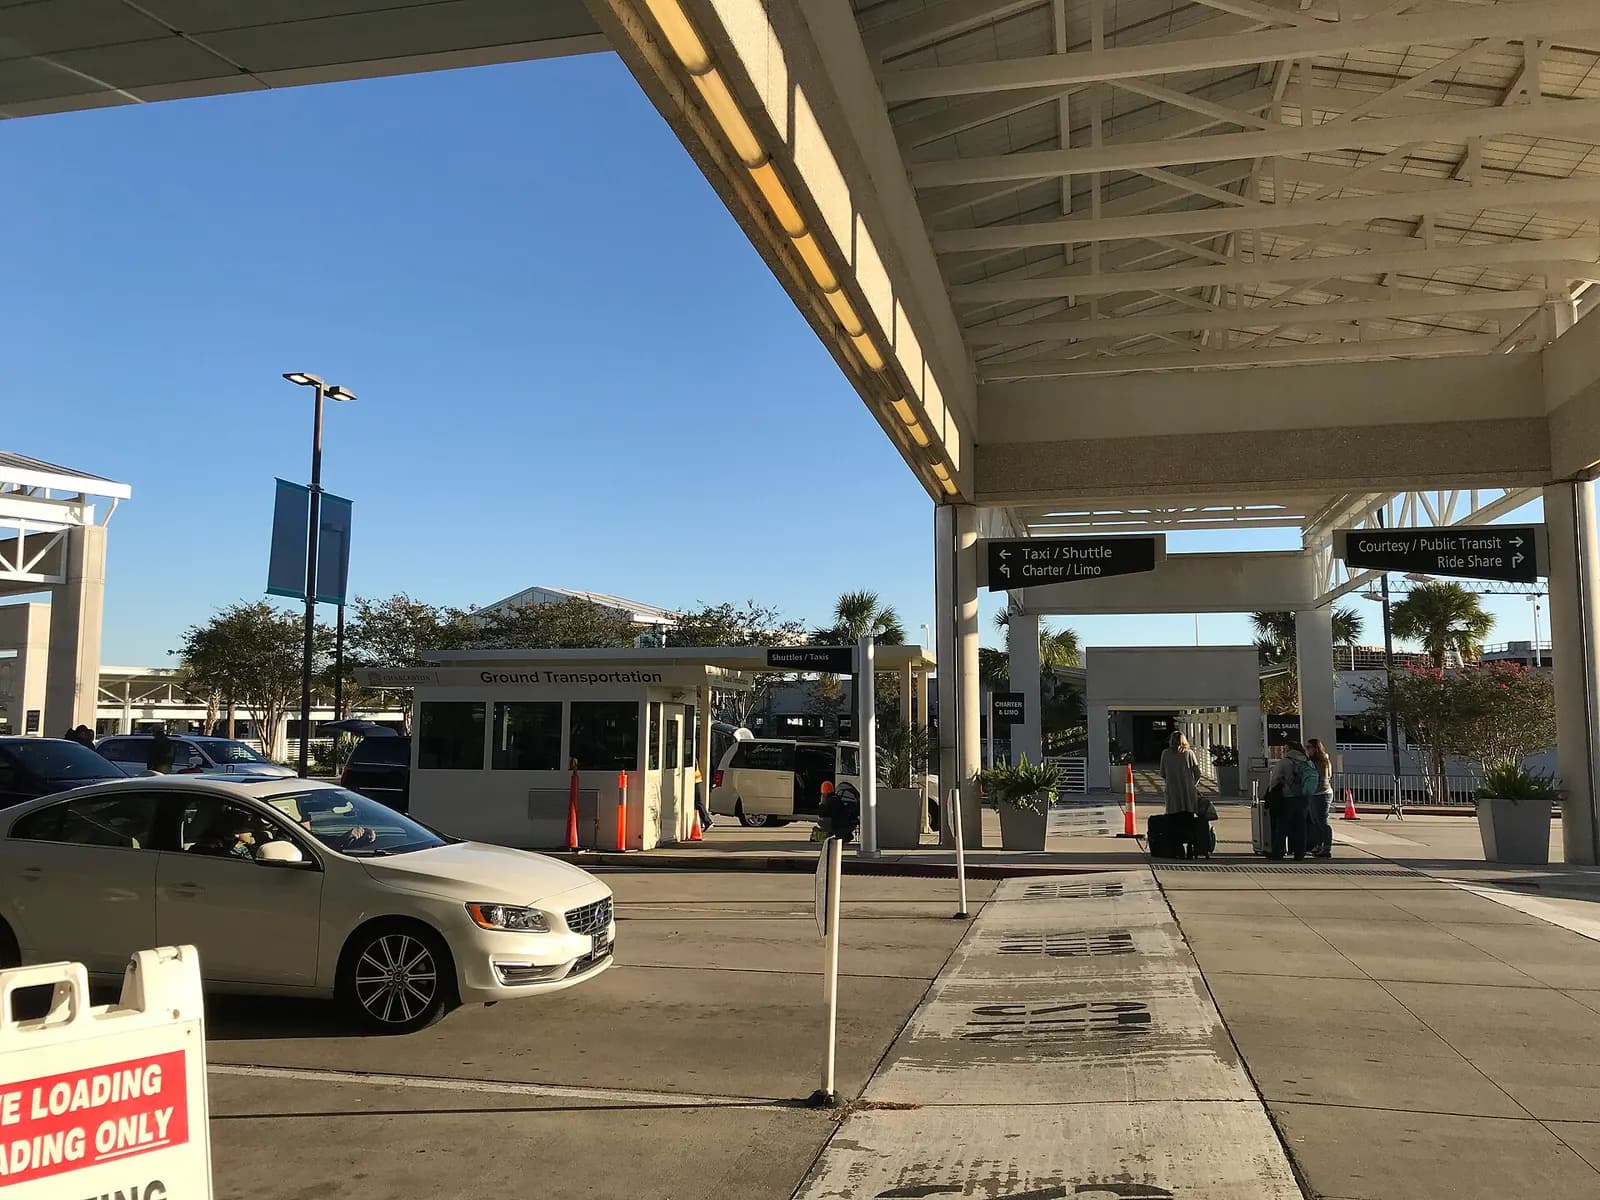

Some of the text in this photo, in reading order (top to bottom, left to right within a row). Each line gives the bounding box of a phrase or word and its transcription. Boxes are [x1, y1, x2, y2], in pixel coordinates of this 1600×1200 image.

[1359, 536, 1502, 553] Courtesy / Public Transit
[1022, 546, 1112, 560] Taxi / Shuttle
[1437, 554, 1503, 569] Ride Share
[1022, 563, 1101, 576] Charter / Limo
[772, 653, 803, 661] Shuttles
[809, 653, 830, 661] Taxis
[480, 671, 662, 686] Ground Transportation
[0, 1063, 162, 1126] E LOADING
[95, 1106, 174, 1155] ONLY
